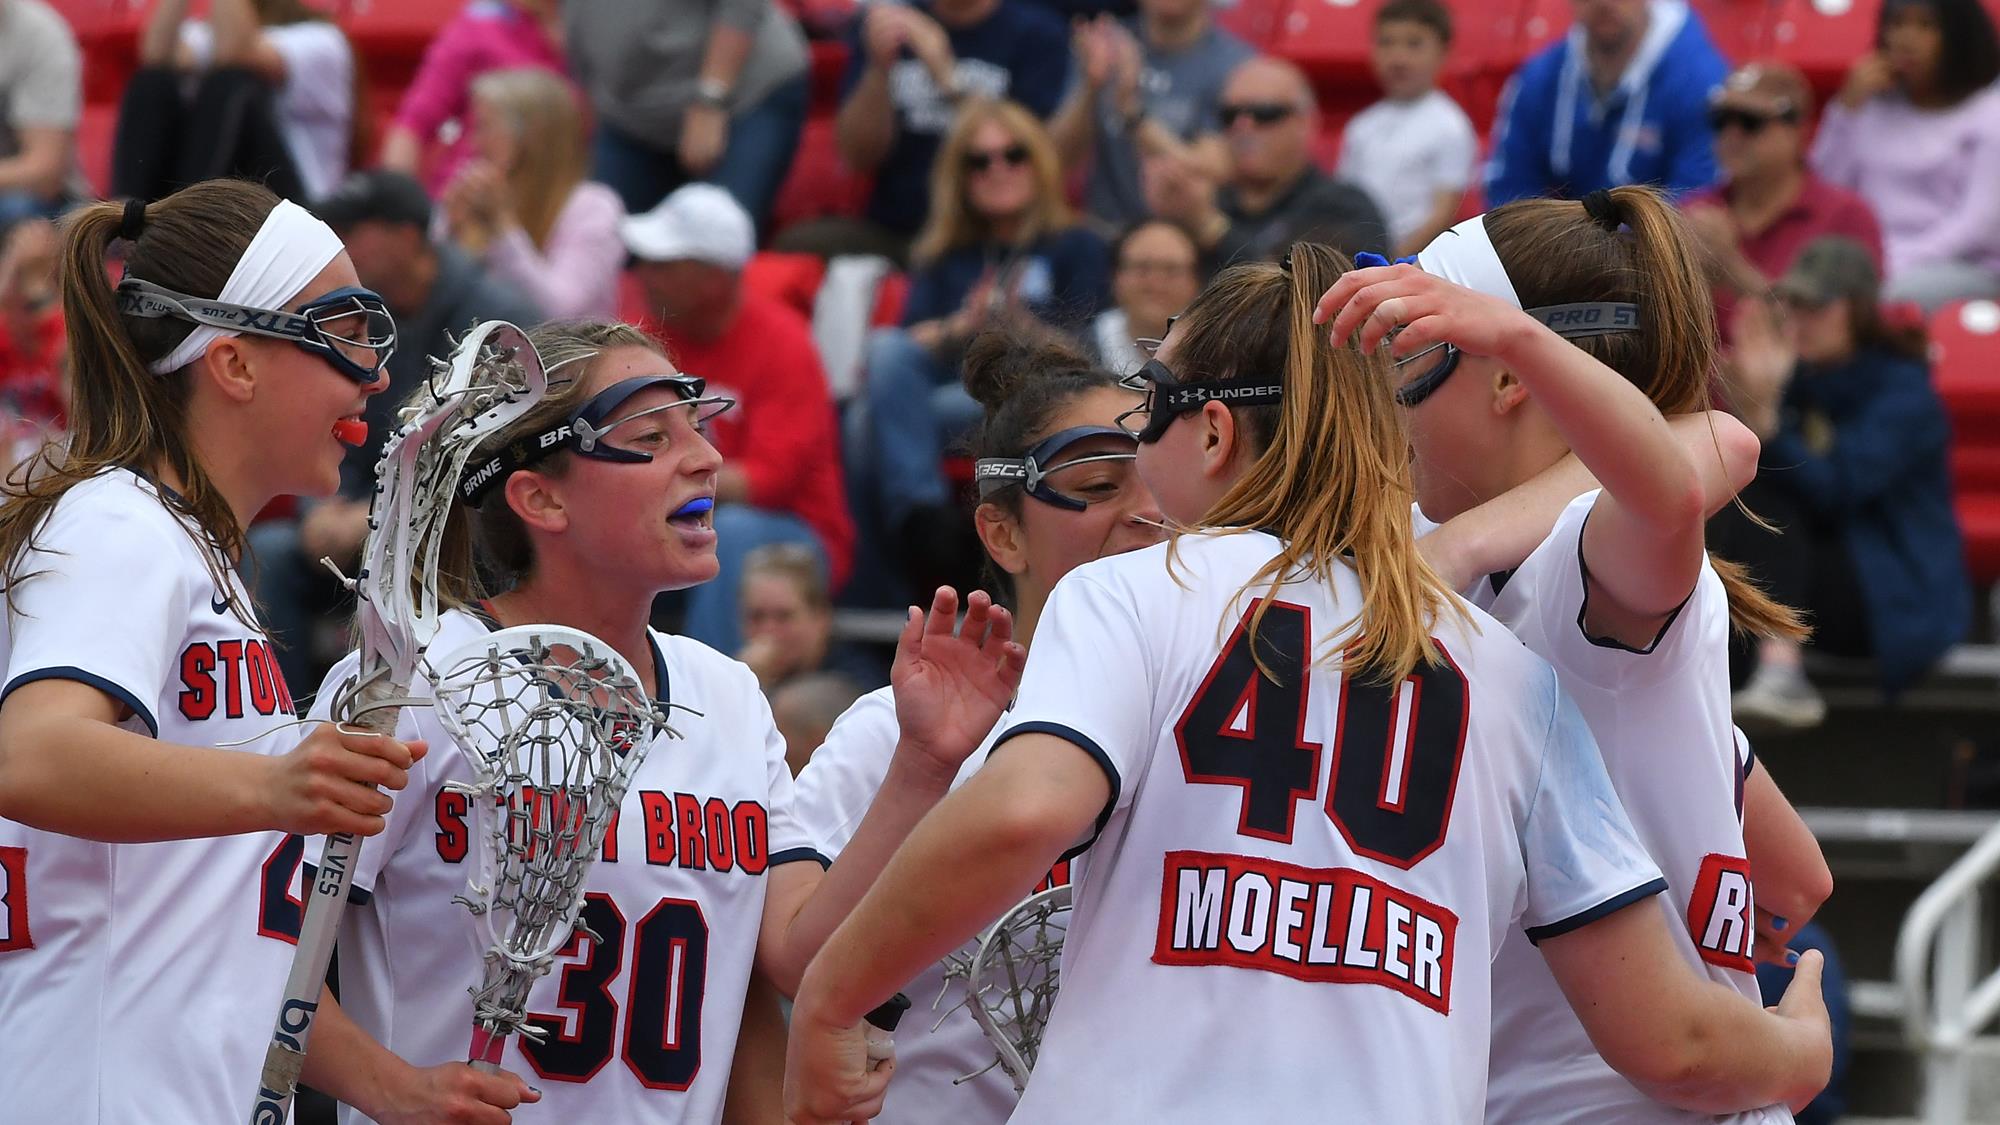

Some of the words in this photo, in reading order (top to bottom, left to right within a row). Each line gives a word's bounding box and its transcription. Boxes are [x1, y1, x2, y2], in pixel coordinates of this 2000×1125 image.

[202, 307, 239, 320] PLUS
[1547, 308, 1601, 326] PRO
[1209, 385, 1283, 399] UNDER
[463, 457, 503, 497] BRINE
[1173, 597, 1470, 871] 40
[638, 789, 769, 876] BROO
[1171, 865, 1445, 999] MOELLER
[517, 891, 710, 1093] 30
